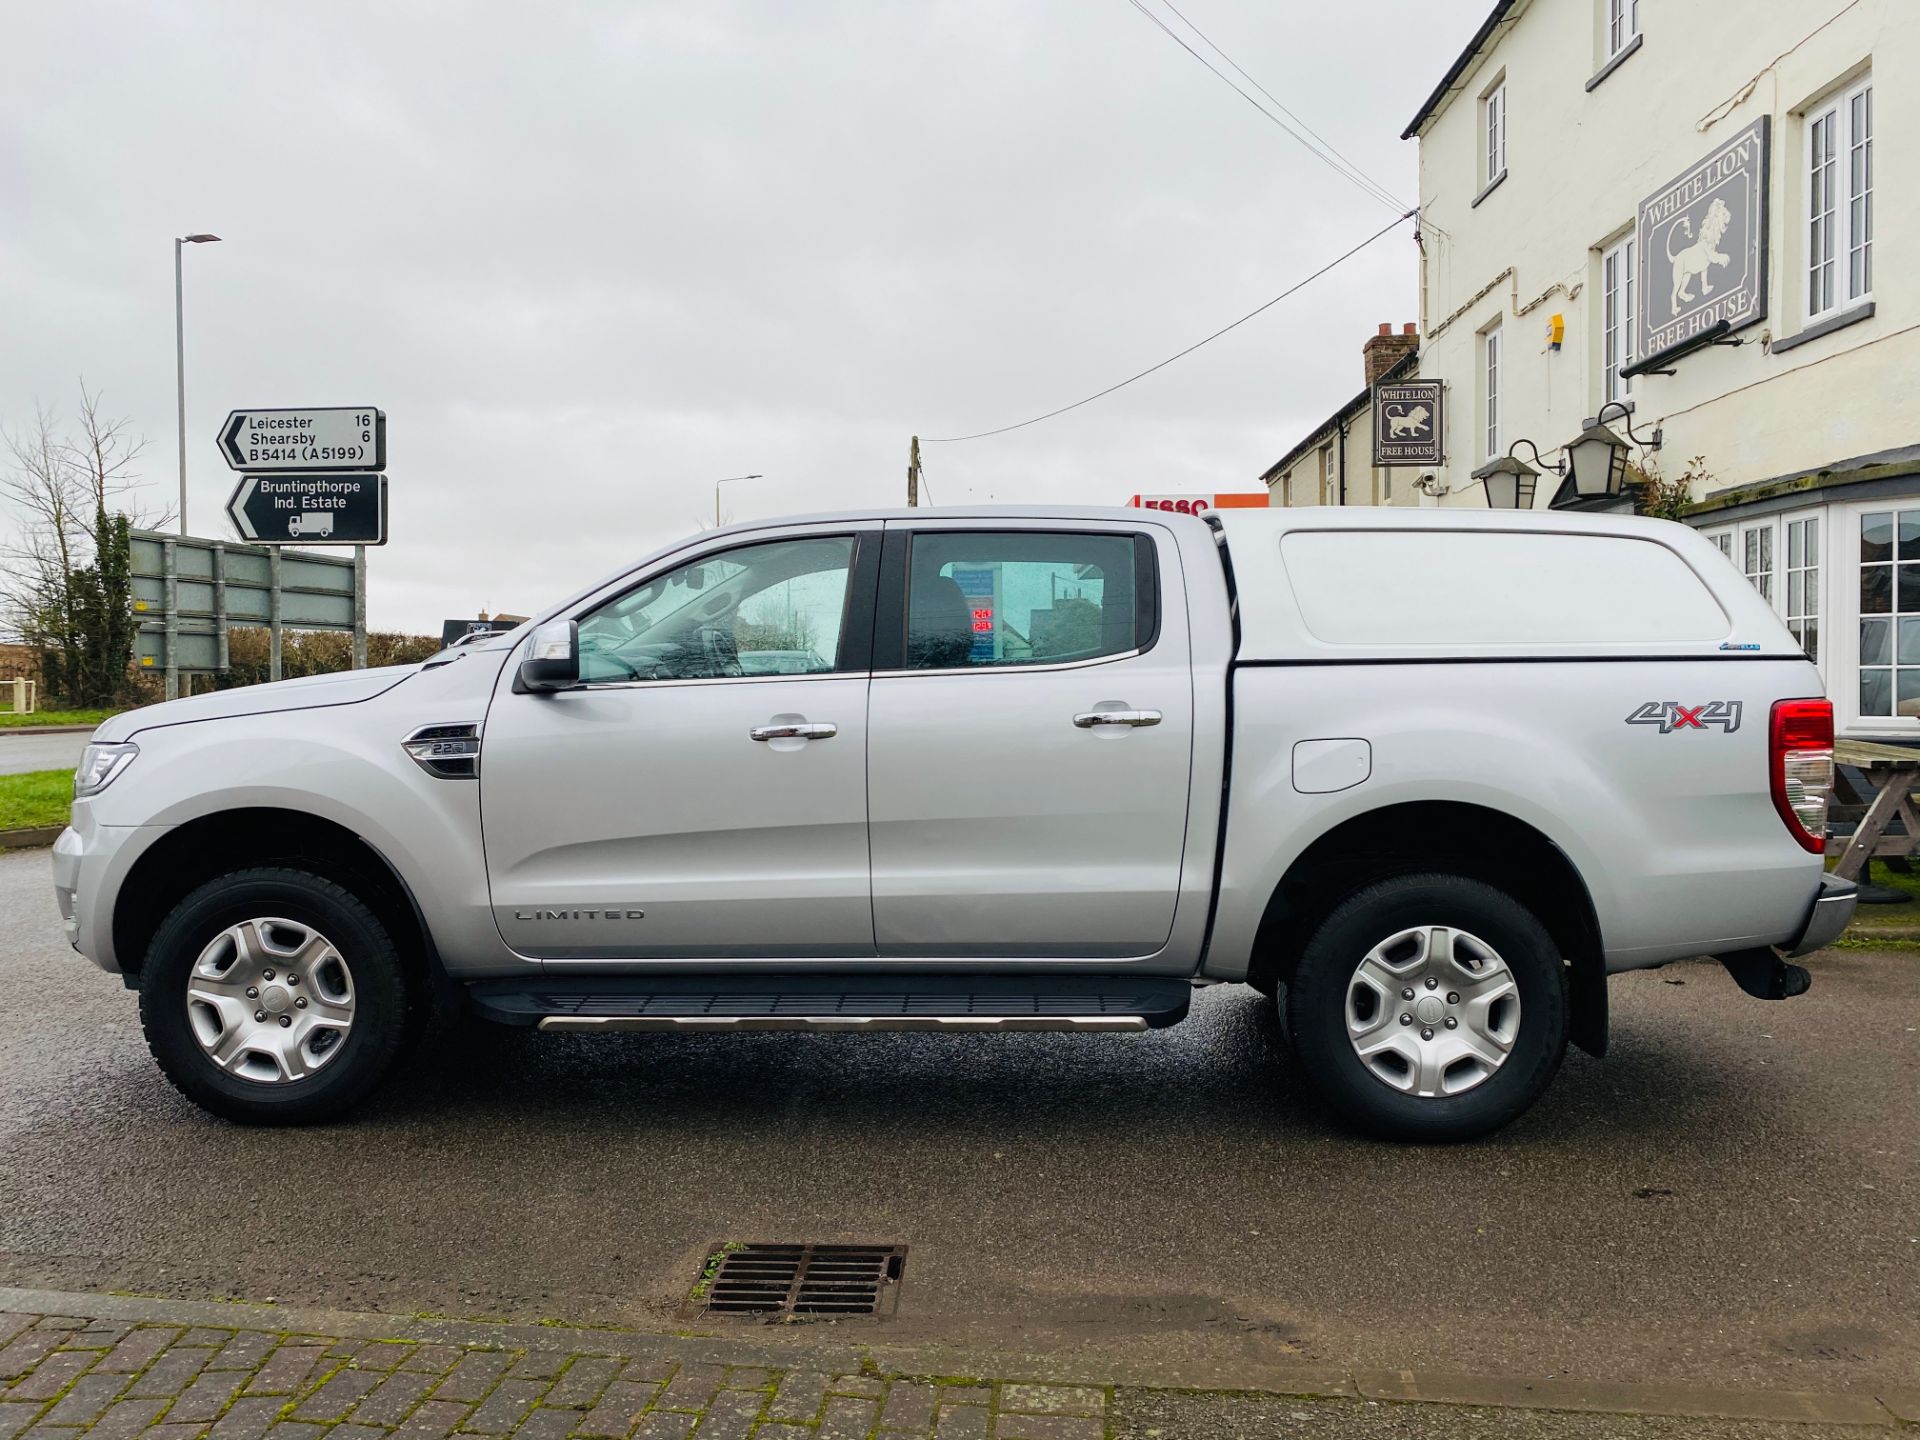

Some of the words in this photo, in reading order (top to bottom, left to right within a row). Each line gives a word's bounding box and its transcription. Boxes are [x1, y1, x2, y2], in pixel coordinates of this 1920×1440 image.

[1649, 177, 1703, 225] WHITE
[1707, 140, 1752, 186] LION
[1648, 321, 1686, 355] FREE
[1689, 290, 1749, 335] HOUSE
[1381, 390, 1411, 399] WHITE
[1412, 390, 1434, 399] LION
[250, 417, 313, 429] Leicester
[355, 415, 370, 427] 16
[250, 432, 316, 446] Shearsby
[362, 430, 371, 442] 6
[302, 446, 364, 461] (A5199)
[1381, 447, 1403, 455] FREE
[1405, 446, 1435, 455] HOUSE
[260, 480, 361, 494] Bruntingthorpe
[275, 497, 297, 509] Ind.
[302, 496, 347, 508] Estate
[515, 909, 645, 920] LIMITED
